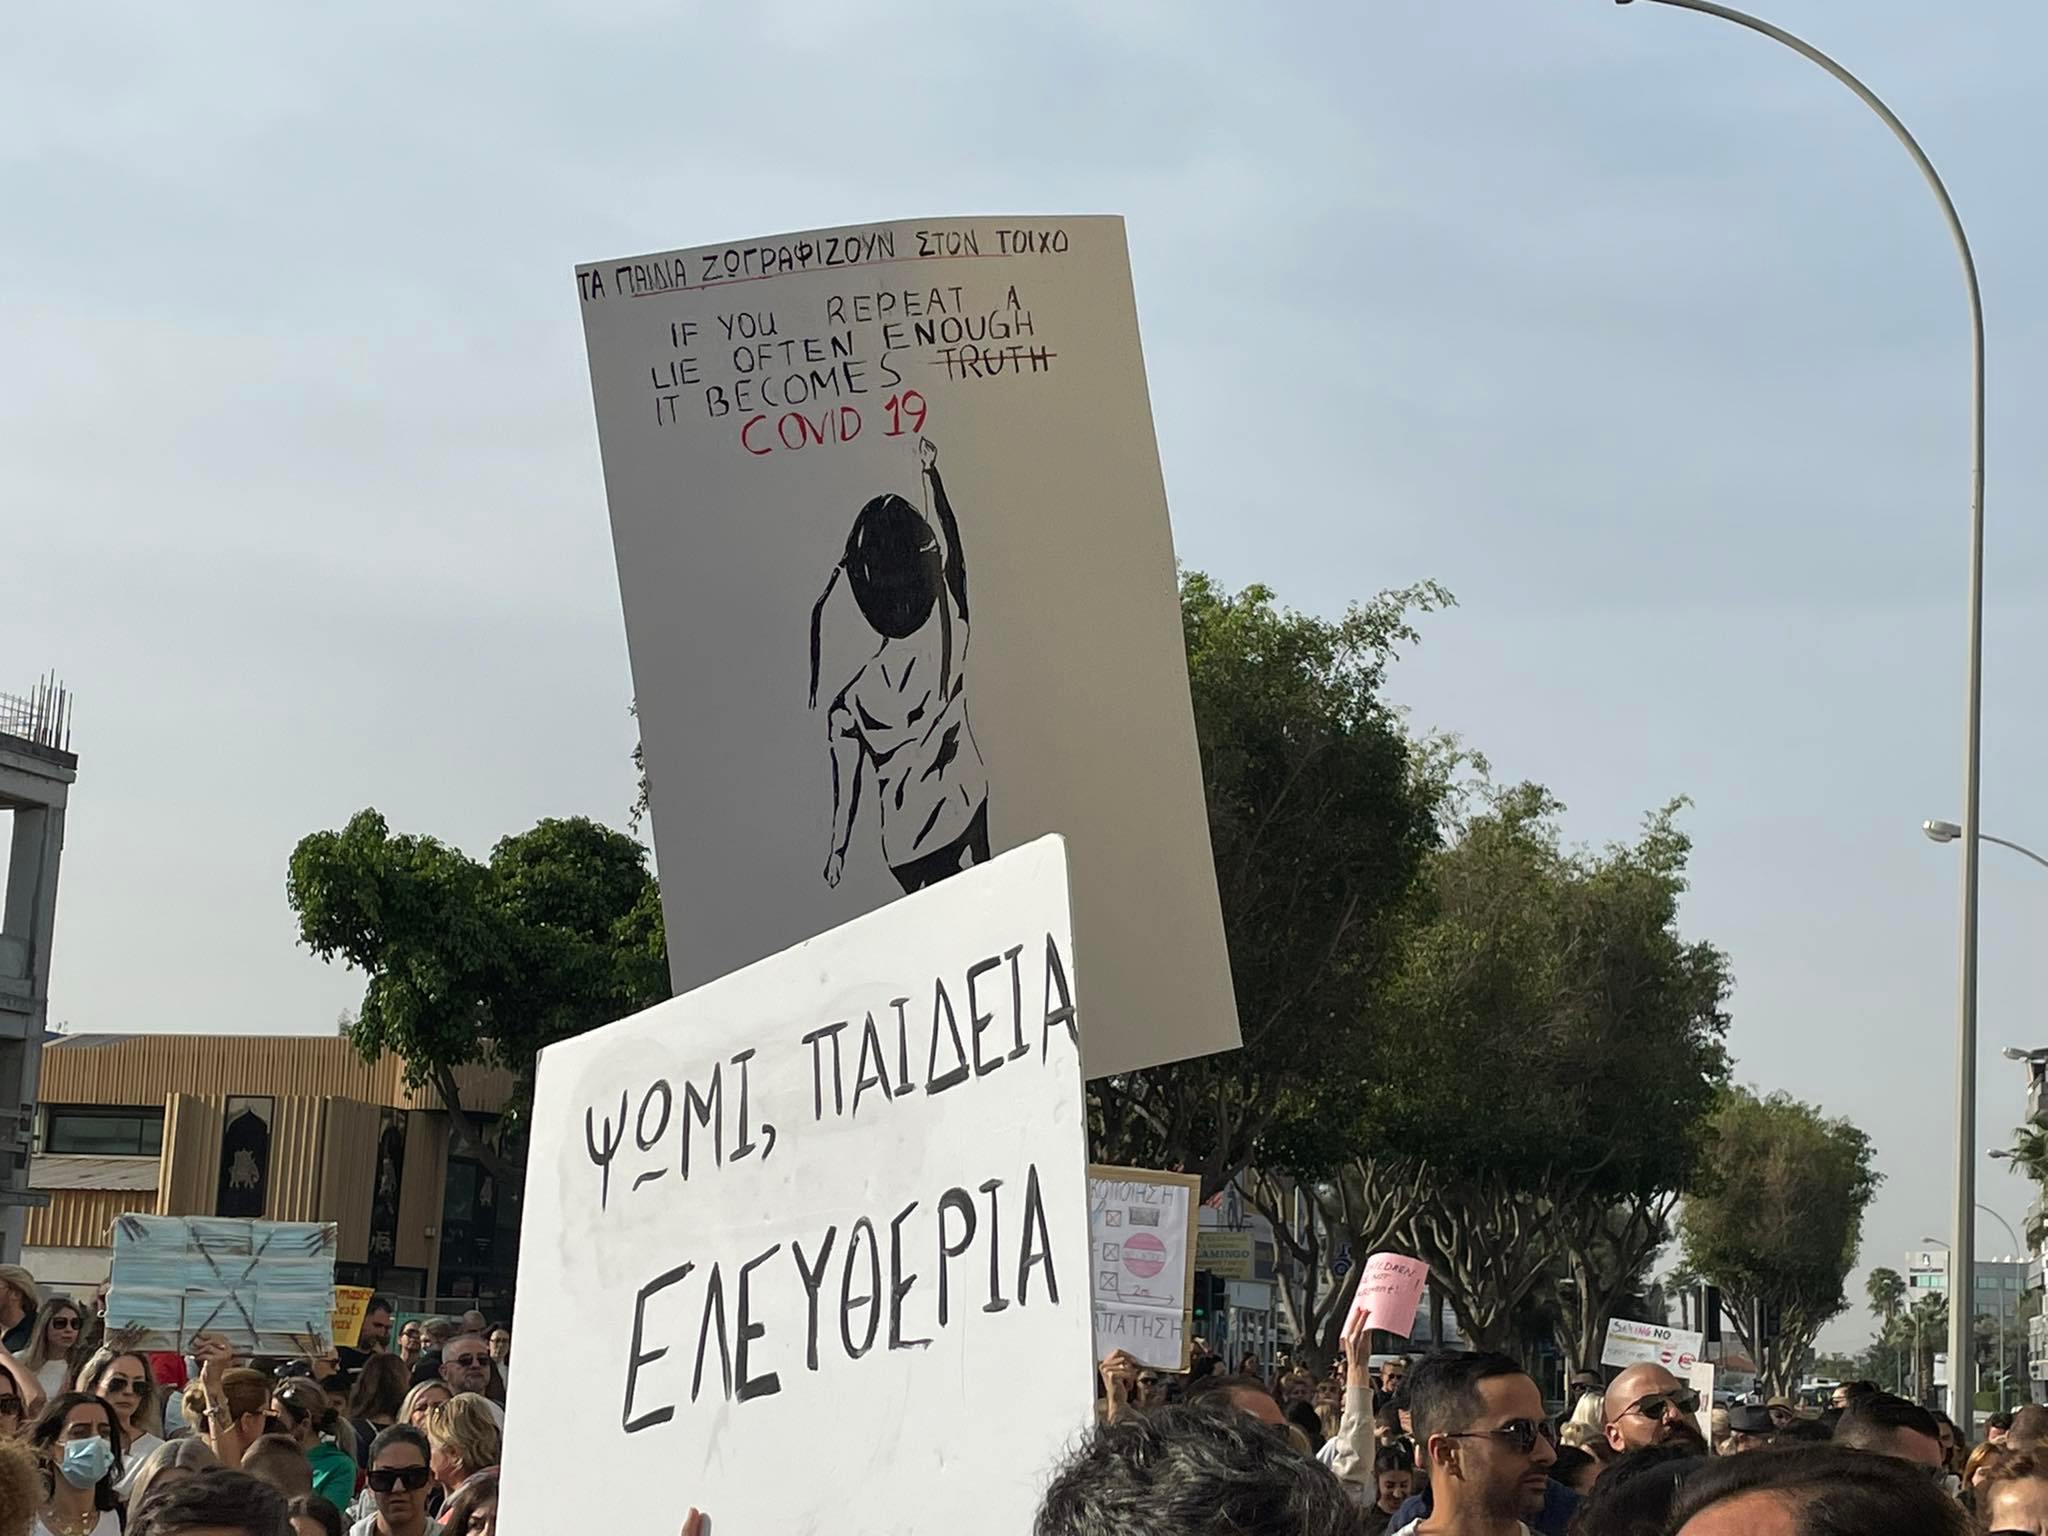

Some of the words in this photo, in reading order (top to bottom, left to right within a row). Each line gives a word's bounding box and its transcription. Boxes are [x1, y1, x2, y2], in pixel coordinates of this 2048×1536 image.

[577, 269, 606, 301] ΤΑ
[615, 258, 688, 295] ΠΑΙΔΙΑ
[915, 230, 980, 257] ΣΤΟΝ
[995, 229, 1069, 254] ΤΟΙΧΟ
[651, 358, 701, 390] LIE
[733, 330, 853, 374] OFTEN
[882, 310, 1035, 350] ENOUGH
[670, 322, 698, 348] IF
[717, 312, 778, 341] YOU
[826, 286, 963, 326] REPEAT
[1006, 285, 1022, 311] A
[655, 394, 680, 427] IT
[705, 351, 902, 418] BECOMES
[936, 344, 1050, 382] TRUTH
[741, 405, 862, 455] COVID
[883, 389, 928, 437] 19
[801, 931, 1079, 1121] ΠΑΙΔΕΙΑ
[1197, 1249, 1250, 1259] AMINGO
[622, 1162, 1060, 1434] ΕΛΕΥΘΕΡΙΑ
[1653, 1327, 1672, 1340] NO
